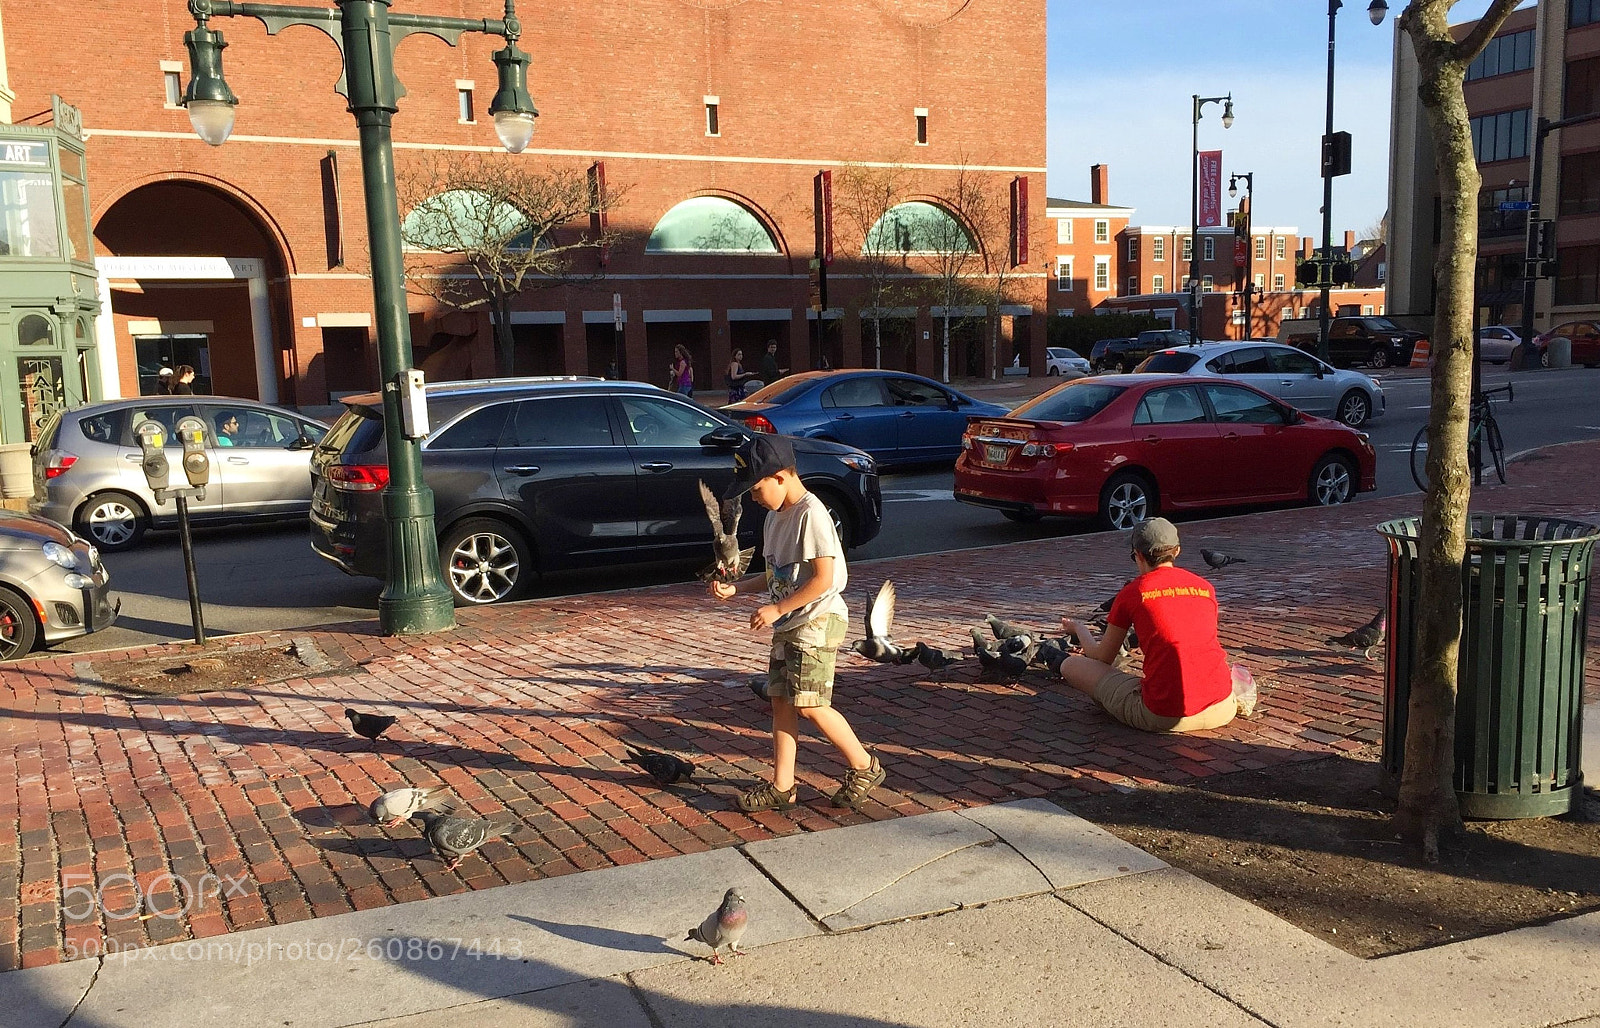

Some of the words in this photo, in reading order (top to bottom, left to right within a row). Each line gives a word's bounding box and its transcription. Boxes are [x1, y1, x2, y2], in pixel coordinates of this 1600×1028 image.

[5, 144, 31, 162] ART
[234, 264, 254, 272] ART
[1141, 589, 1162, 602] people
[1162, 586, 1175, 598] only
[1175, 586, 1190, 595] think
